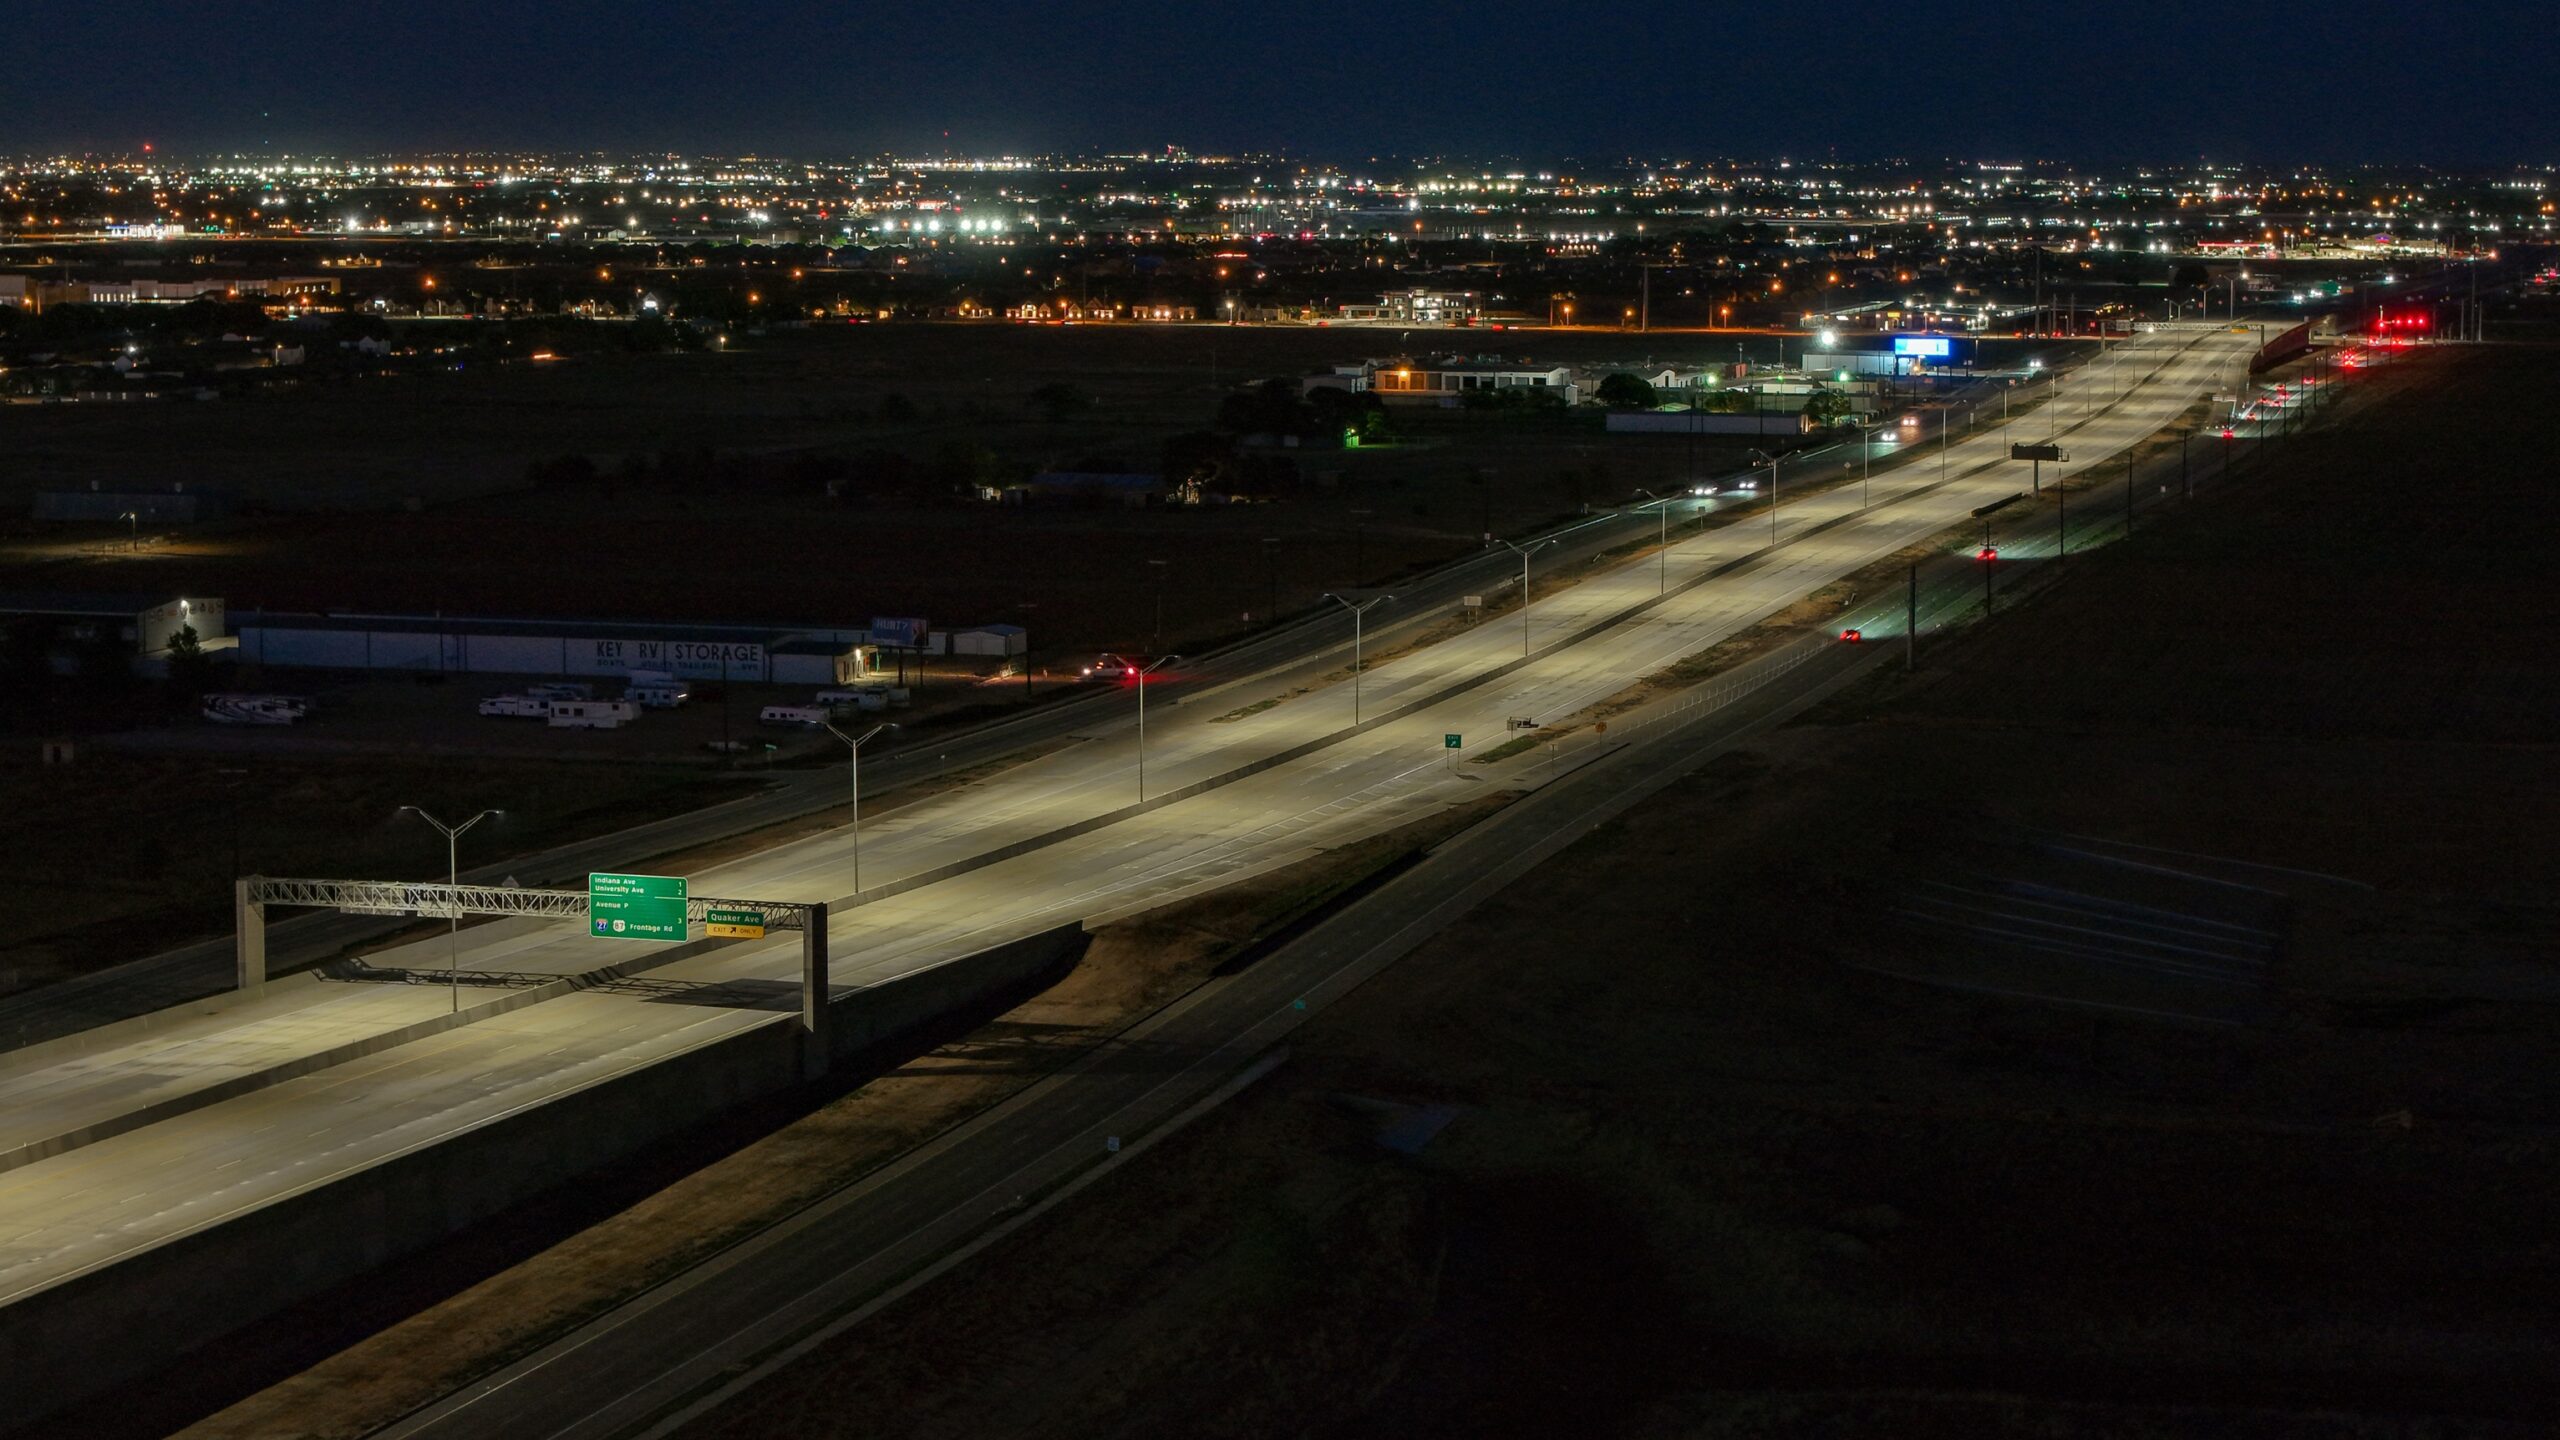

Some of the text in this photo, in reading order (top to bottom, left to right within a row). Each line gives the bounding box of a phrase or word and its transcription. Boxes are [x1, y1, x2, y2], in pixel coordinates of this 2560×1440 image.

[596, 641, 758, 661] KEY RV STORAGE
[594, 886, 629, 894] University
[710, 913, 760, 923] Quaker Ave
[614, 922, 624, 930] 87
[629, 923, 661, 933] Frontage
